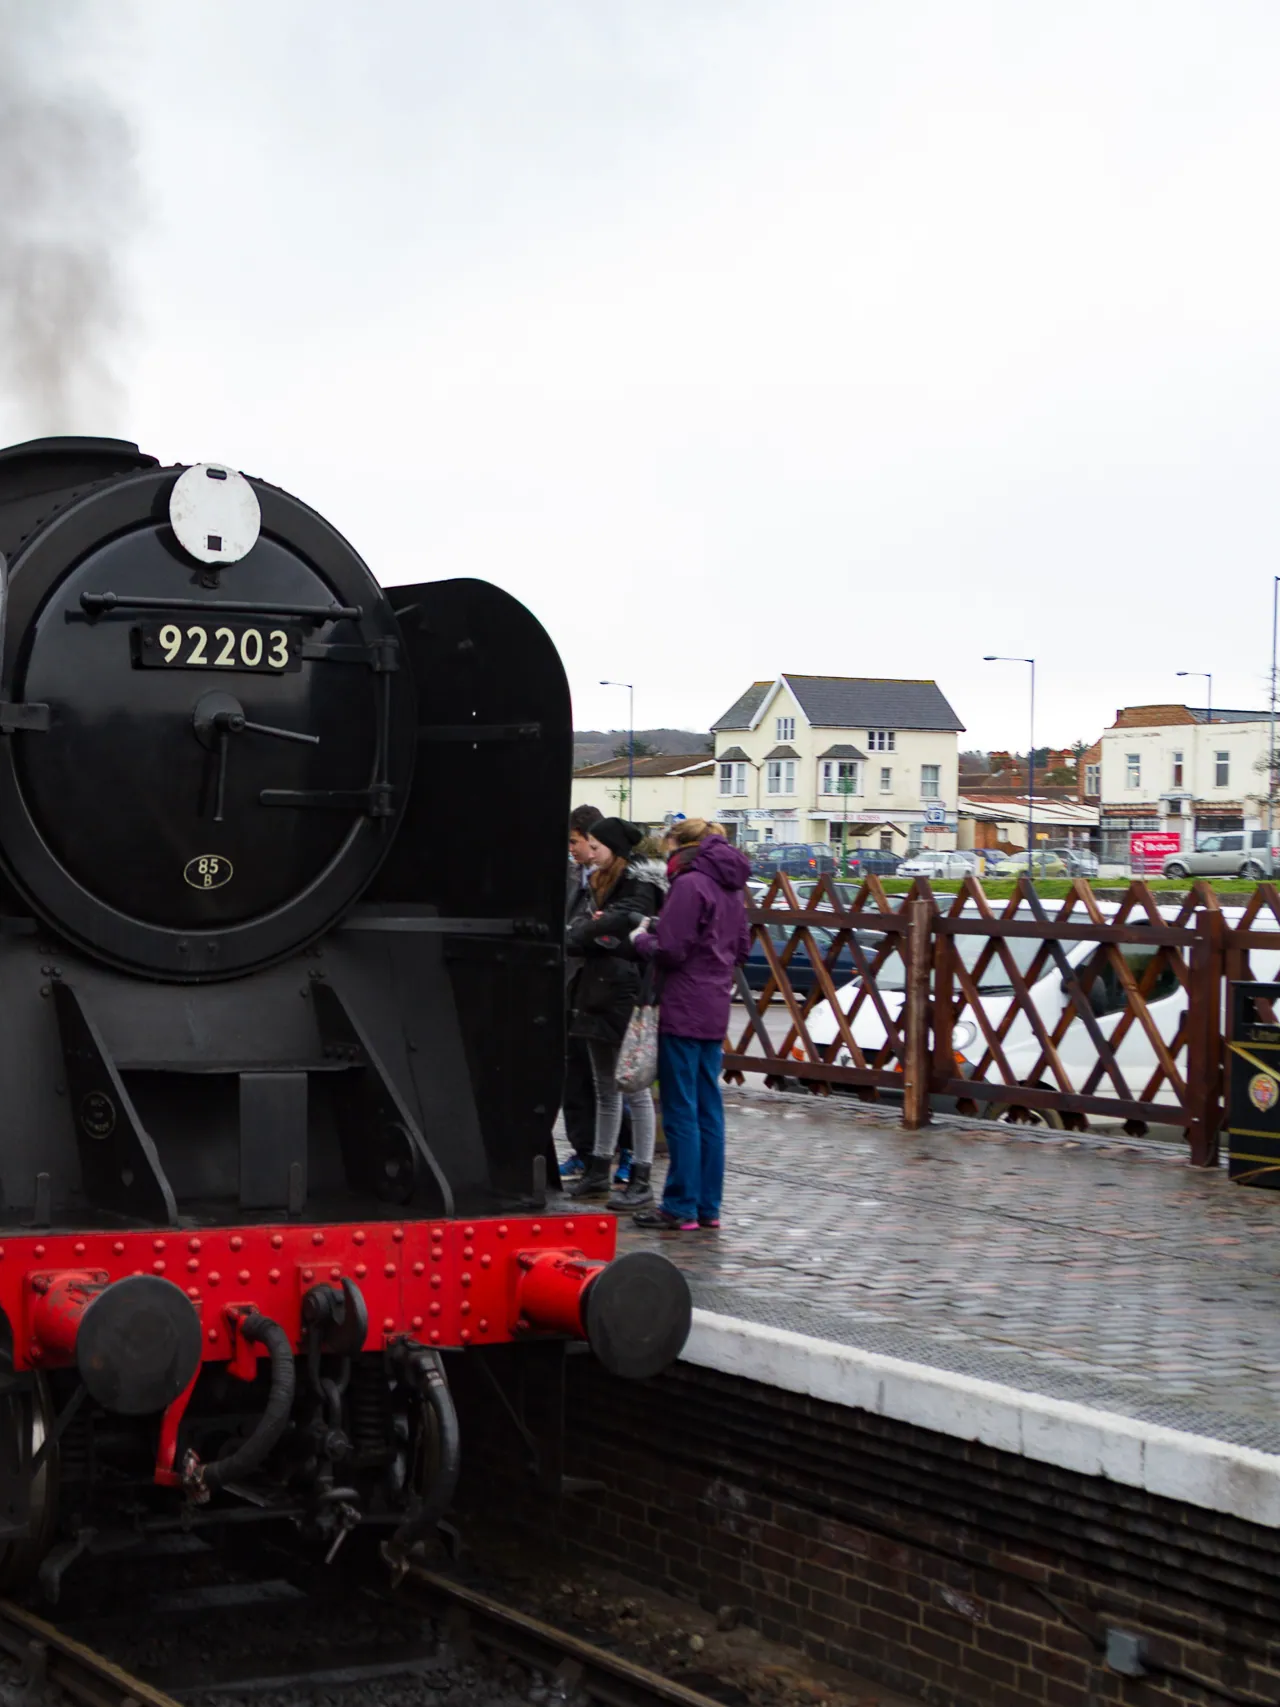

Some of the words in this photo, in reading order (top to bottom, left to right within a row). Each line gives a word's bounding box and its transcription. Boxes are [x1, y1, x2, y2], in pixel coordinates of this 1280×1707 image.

[158, 624, 289, 668] 92203
[198, 858, 219, 875] 85
[203, 873, 213, 887] B
